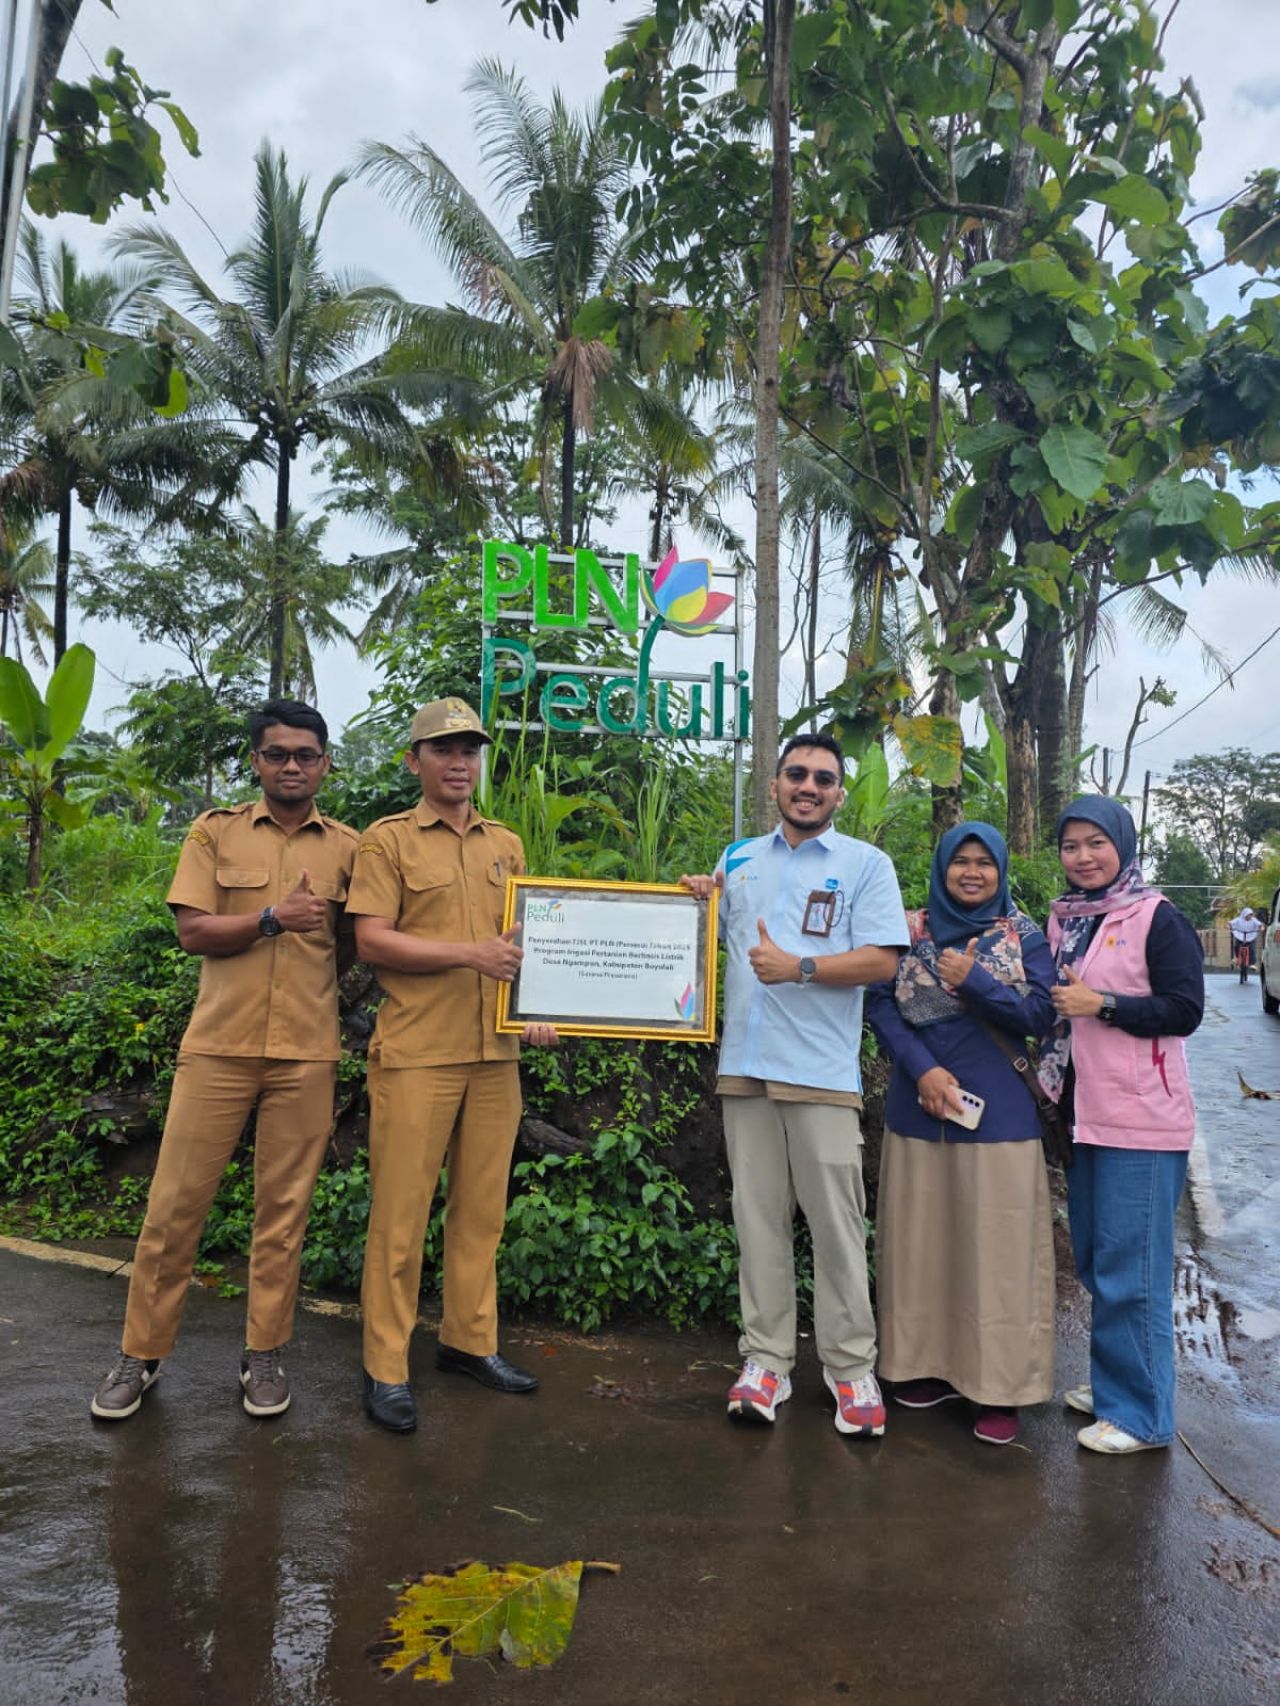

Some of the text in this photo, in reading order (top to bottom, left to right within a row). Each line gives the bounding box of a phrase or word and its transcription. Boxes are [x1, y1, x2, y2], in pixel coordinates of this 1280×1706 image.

[481, 540, 640, 635] PLN
[481, 634, 750, 740] Peduli
[527, 903, 547, 912] PLN
[527, 911, 564, 923] Peduli
[533, 947, 566, 956] Program
[591, 949, 627, 958] Pertanian
[628, 951, 660, 959] Berbasis
[660, 953, 684, 961] Listrik
[542, 957, 561, 965] Desa
[602, 960, 643, 970] Kabupaten
[644, 963, 674, 972] Boyolali
